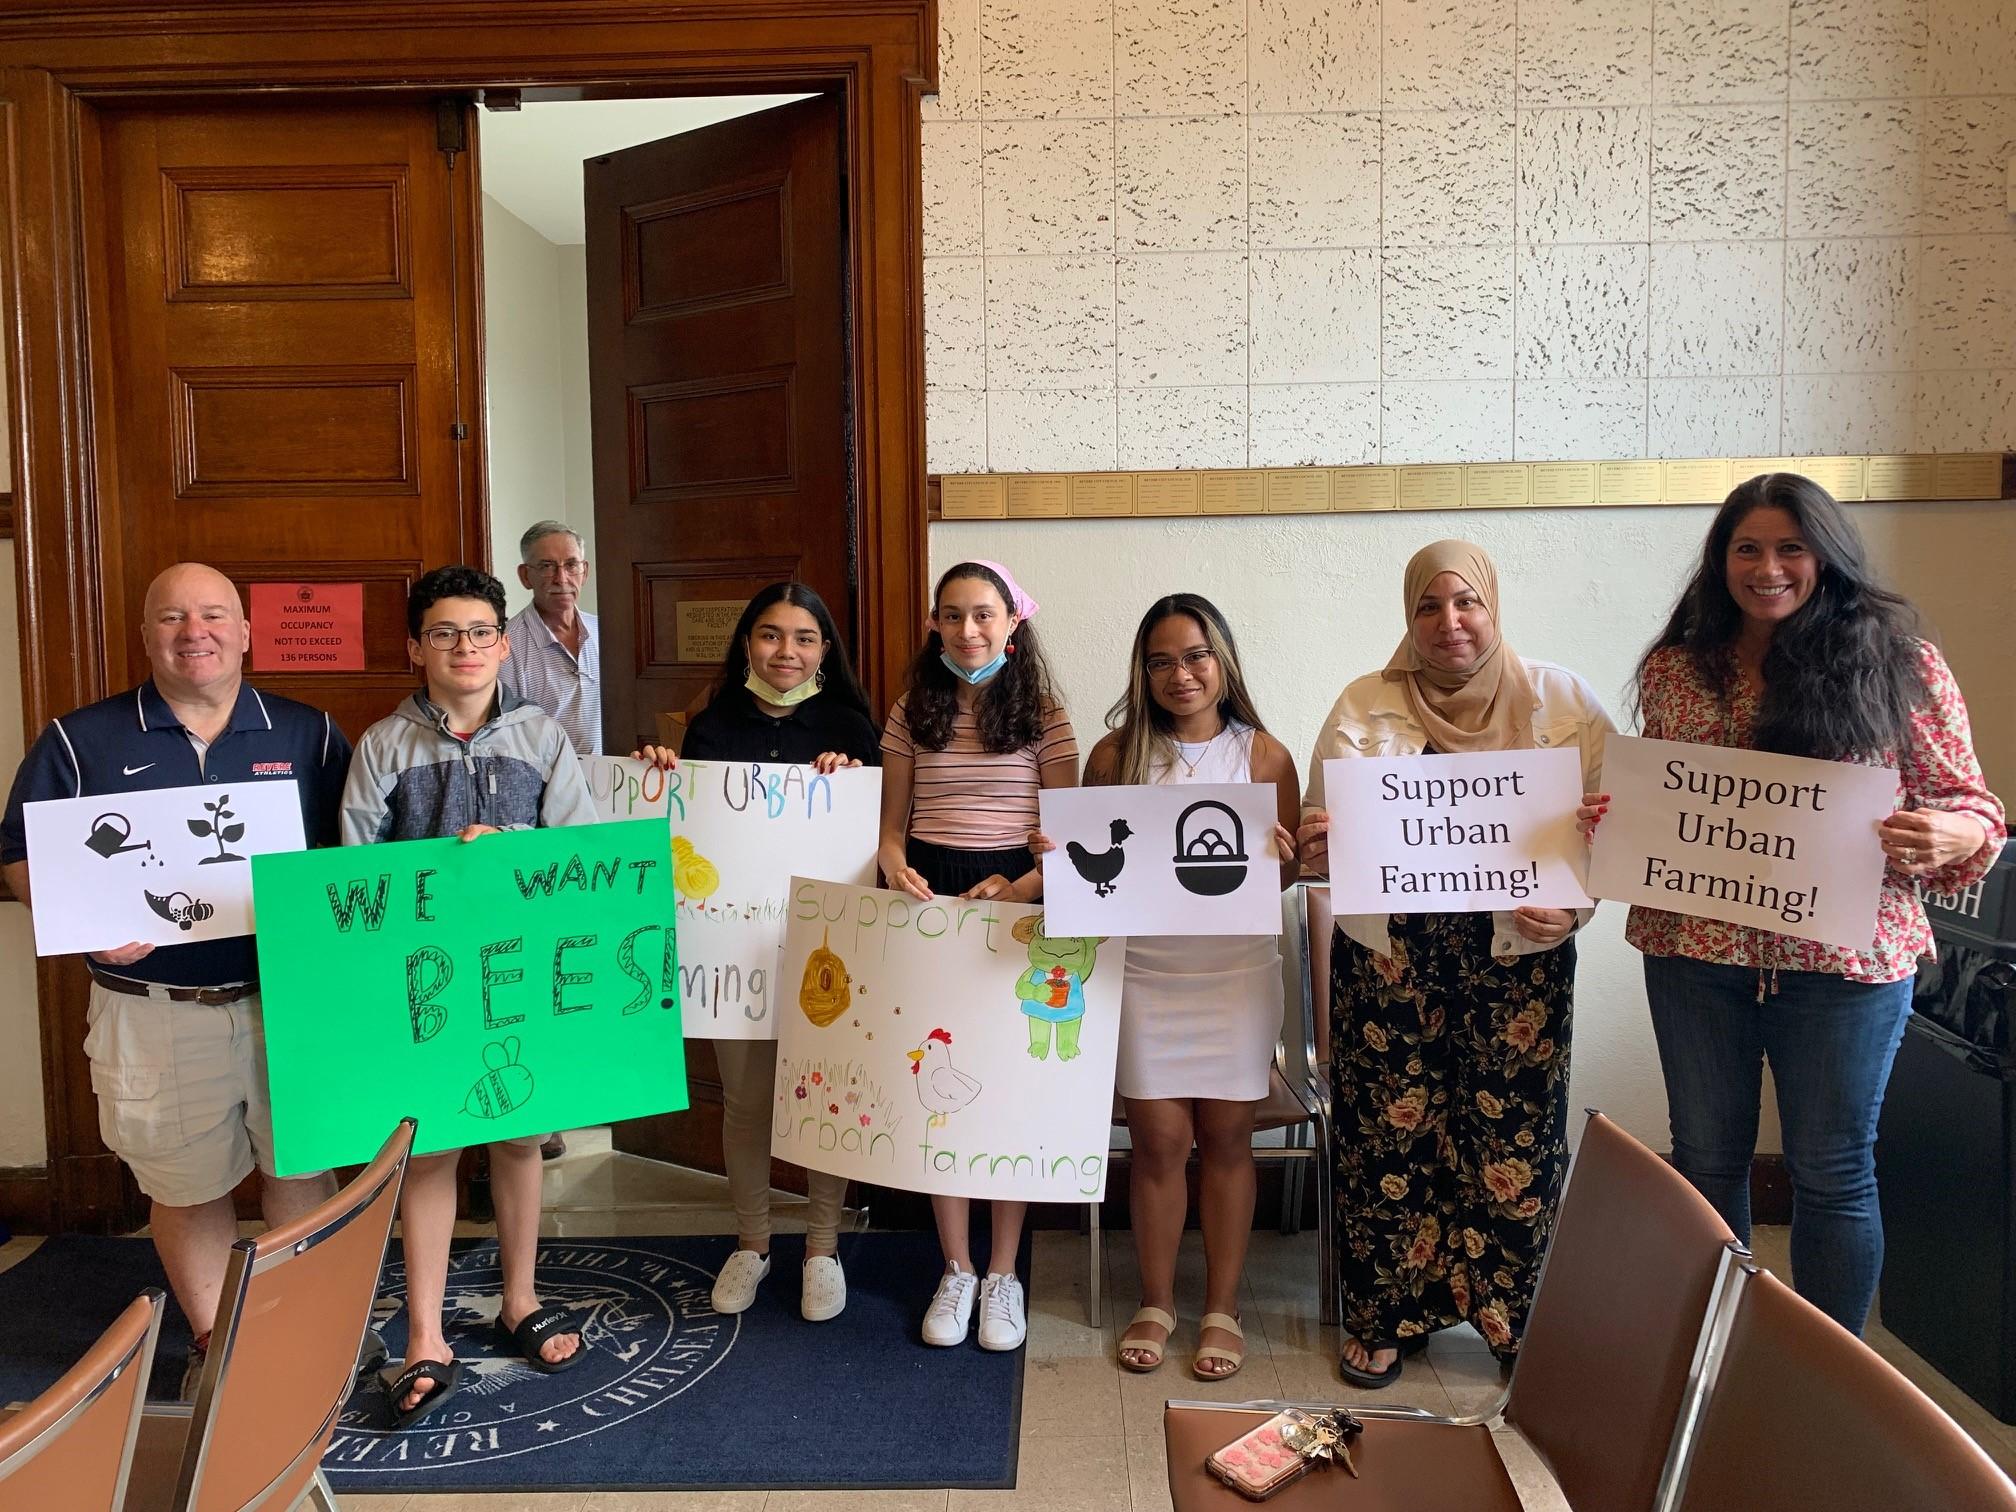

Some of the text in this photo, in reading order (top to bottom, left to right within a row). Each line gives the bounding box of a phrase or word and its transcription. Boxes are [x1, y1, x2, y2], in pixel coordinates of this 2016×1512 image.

[280, 621, 334, 630] OCCUPANCY
[283, 605, 331, 614] MAXIMUM
[274, 637, 342, 646] NOT TO EXCEED
[280, 653, 338, 662] 136 PERSONS
[585, 761, 707, 822] UPPORT
[1381, 769, 1526, 807] Support
[1663, 760, 1828, 813] Support
[1400, 816, 1511, 848] Urban
[1677, 811, 1797, 861] Urban
[326, 854, 657, 933] WE WANT
[1380, 860, 1540, 899] Farming!
[1642, 856, 1819, 924] Farming!
[405, 925, 677, 1044] BEES!
[678, 964, 768, 1022] ming
[919, 1115, 1103, 1195] farming
[416, 1411, 472, 1426] CIT
[322, 1427, 501, 1462] REVE
